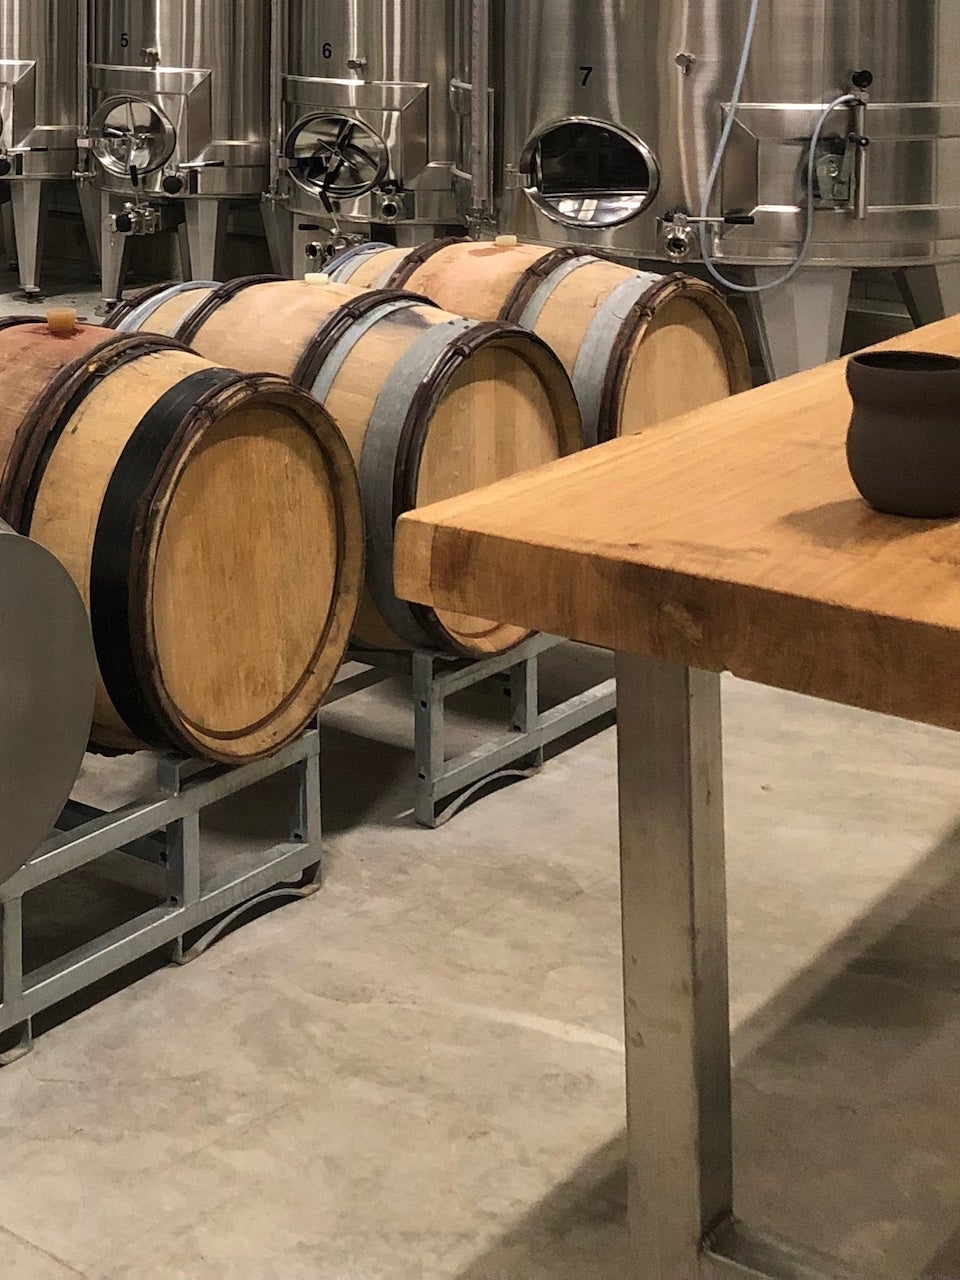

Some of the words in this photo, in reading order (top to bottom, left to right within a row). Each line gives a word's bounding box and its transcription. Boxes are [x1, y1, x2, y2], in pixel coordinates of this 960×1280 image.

[120, 33, 129, 48] 5
[322, 42, 332, 59] 6
[579, 66, 593, 86] 7
